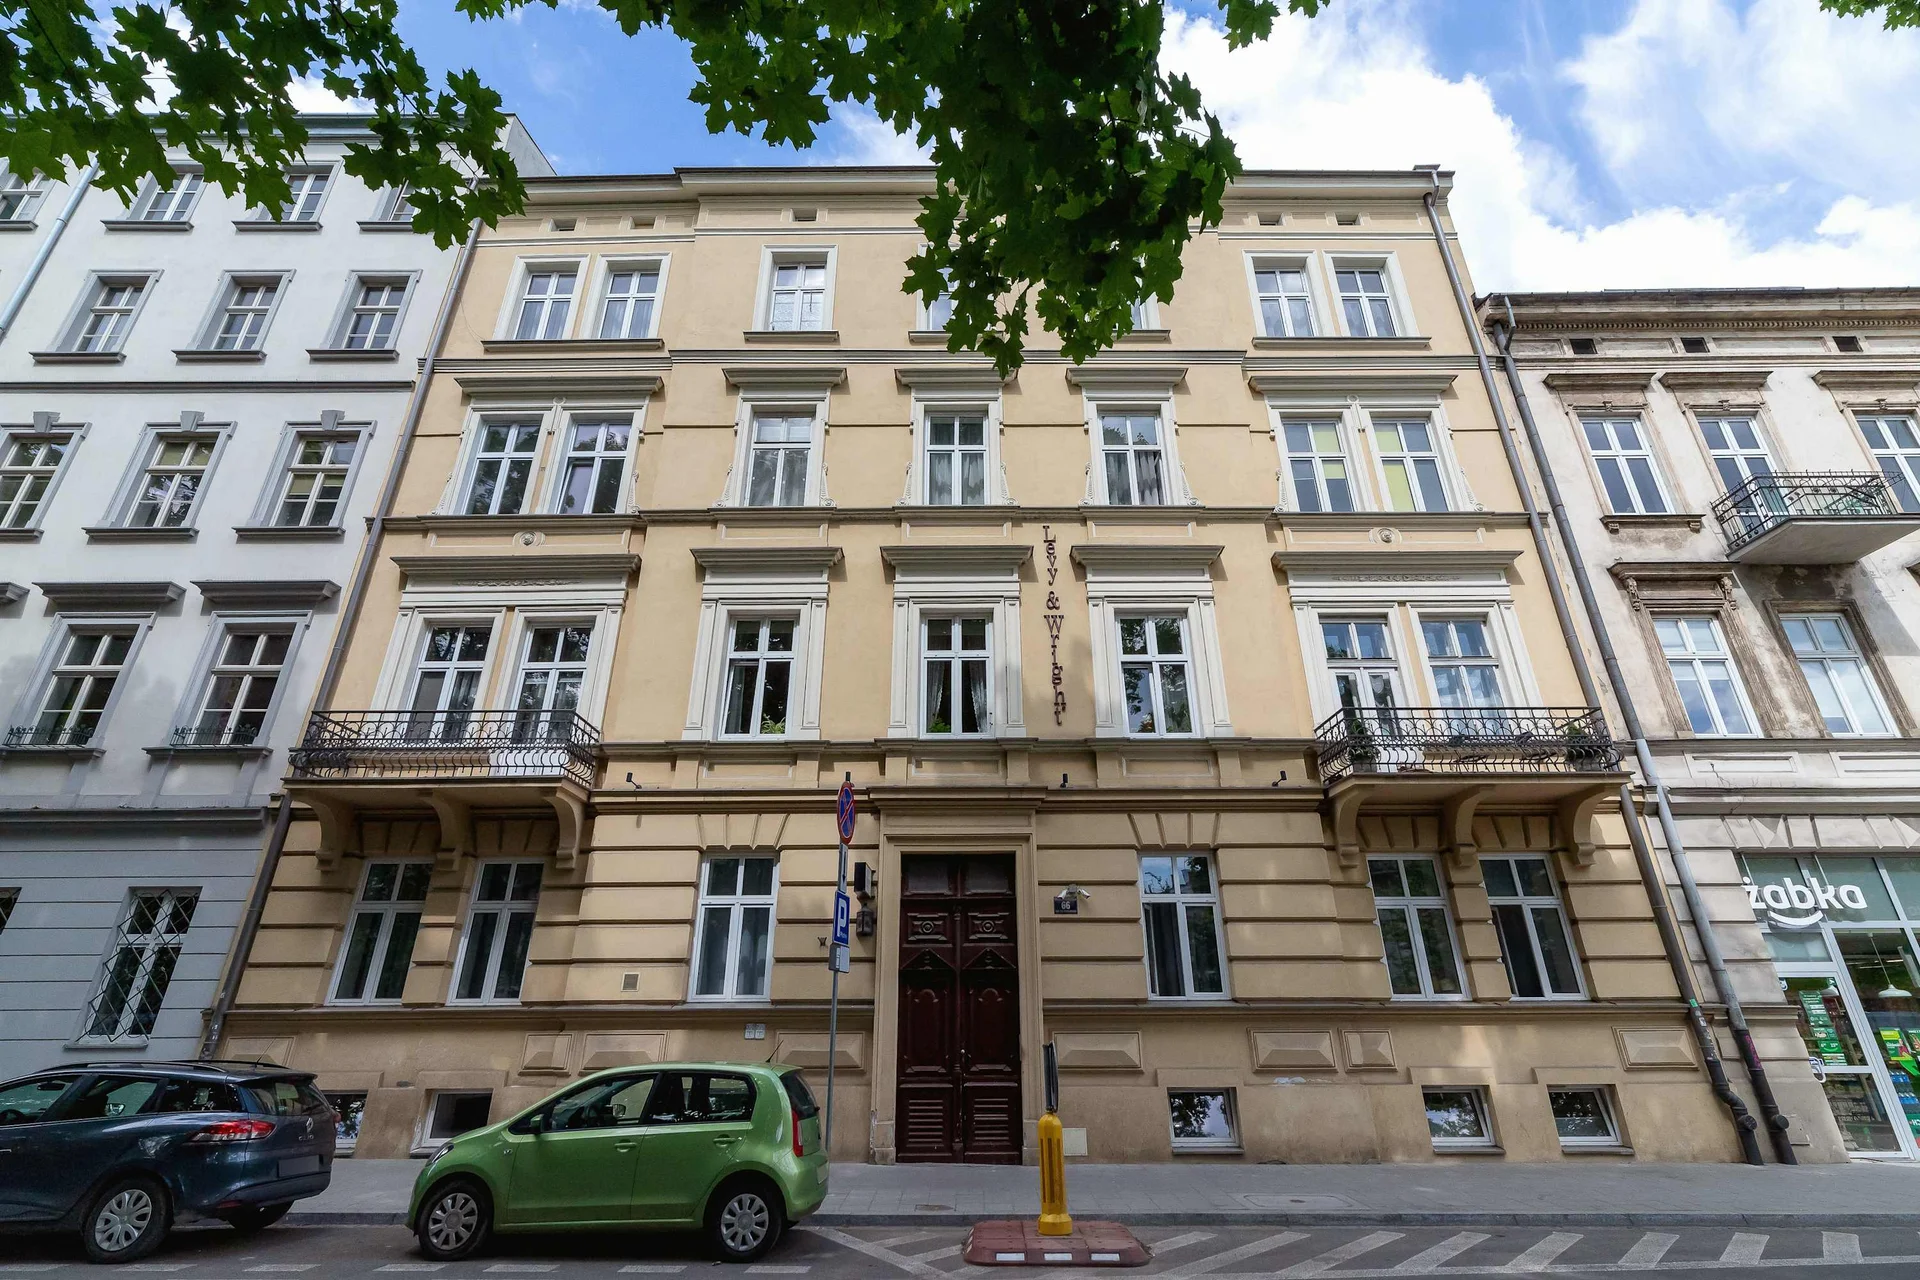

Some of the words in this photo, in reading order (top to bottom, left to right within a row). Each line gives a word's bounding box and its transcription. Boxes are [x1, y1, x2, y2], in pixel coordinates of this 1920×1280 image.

[1042, 525, 1058, 586] Levy
[1046, 591, 1060, 611] &
[1043, 614, 1067, 726] Wright
[1061, 900, 1071, 910] 66
[1741, 876, 1868, 909] żabka
[837, 897, 847, 938] P
